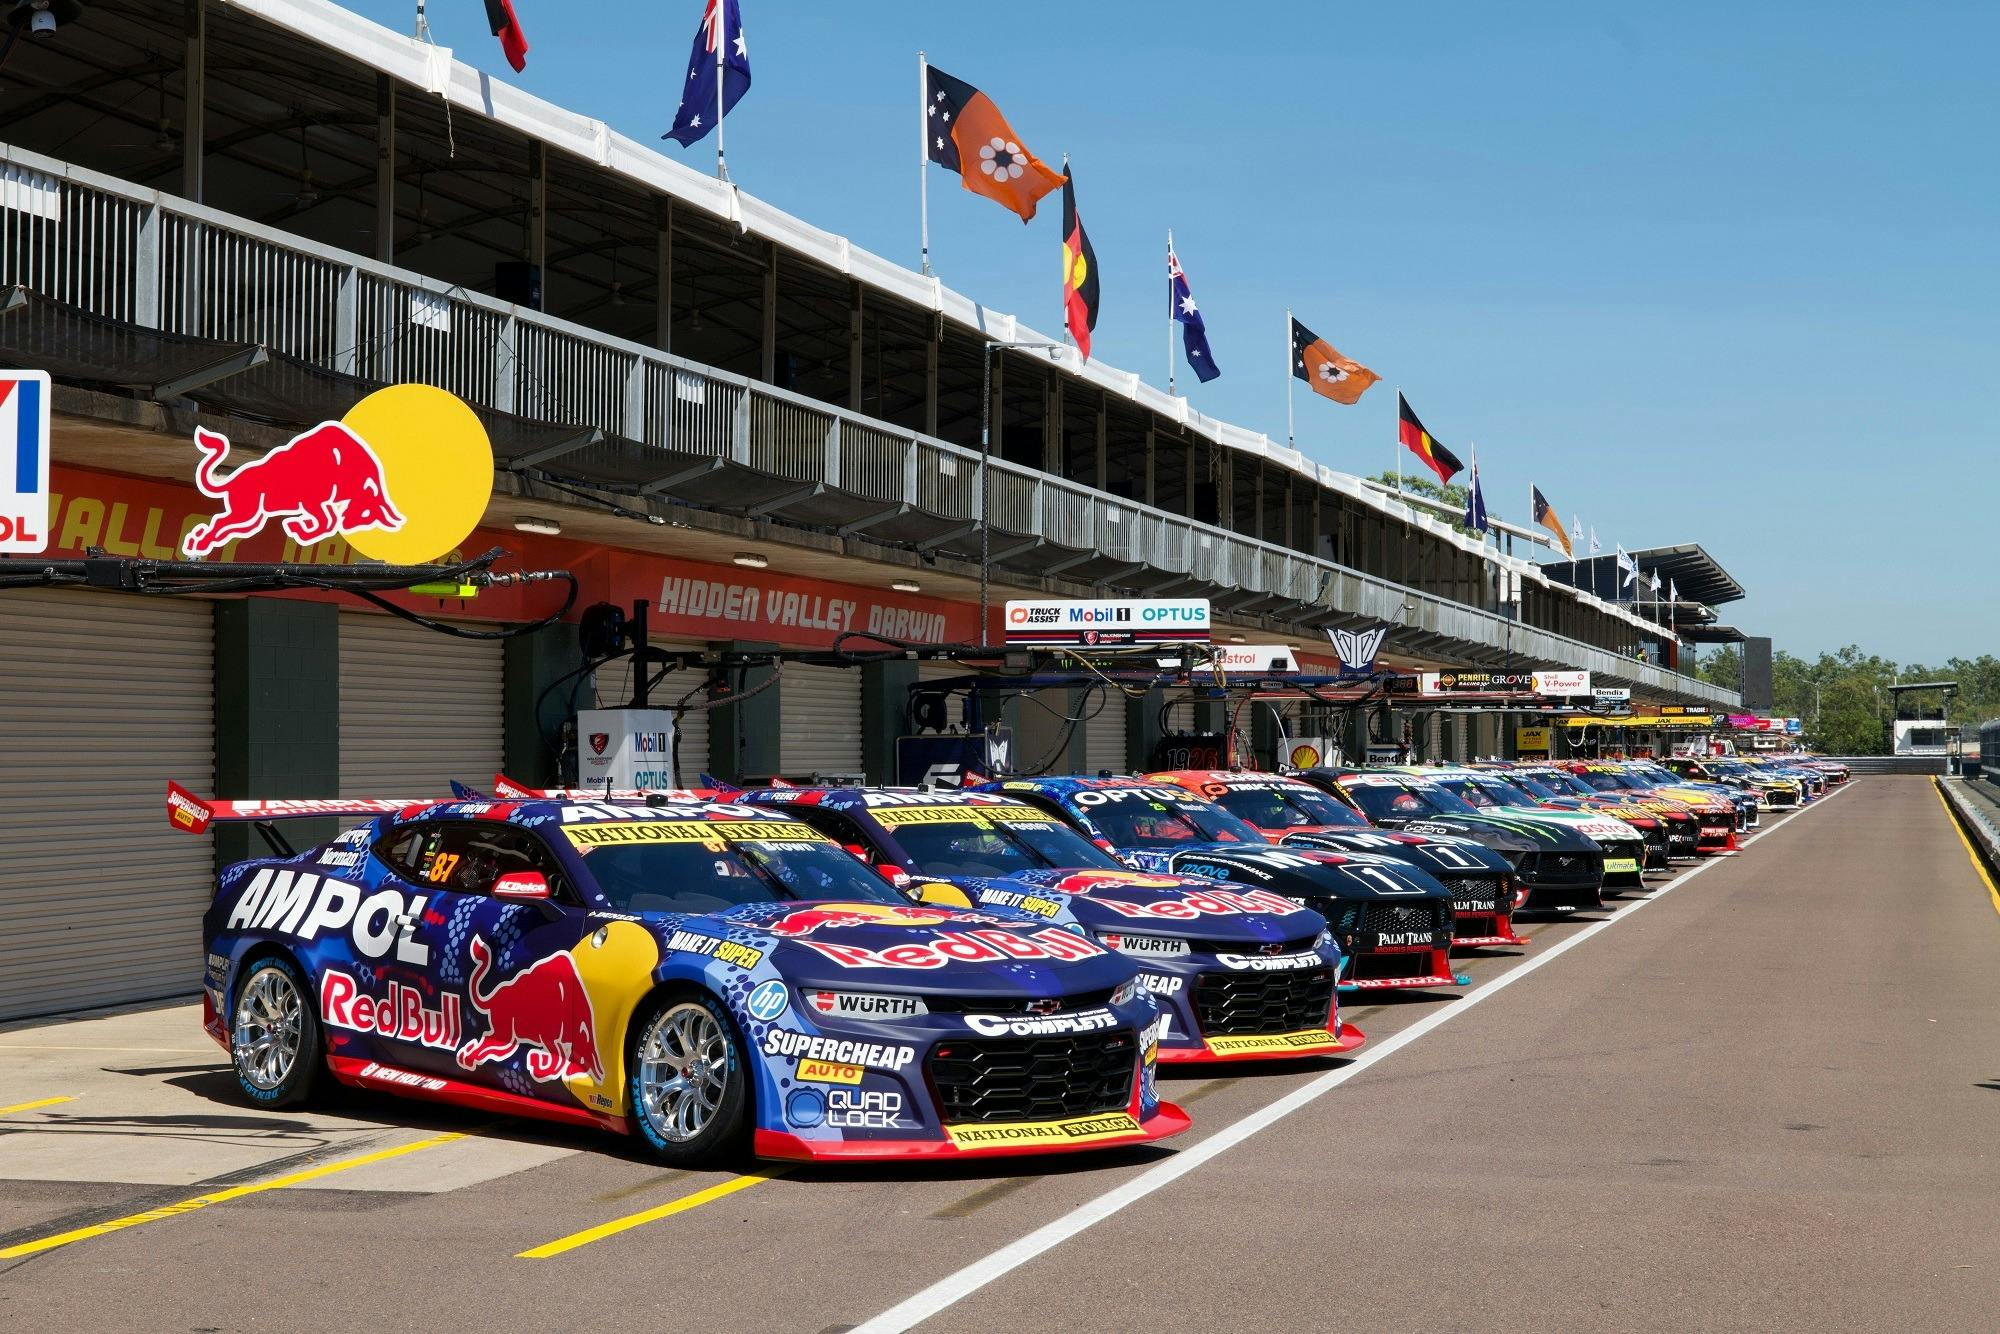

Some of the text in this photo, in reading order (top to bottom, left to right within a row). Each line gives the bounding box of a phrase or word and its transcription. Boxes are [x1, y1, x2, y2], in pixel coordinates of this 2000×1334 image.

[659, 576, 946, 644] HIDDEN VALLEY DARWIN
[1027, 615, 1061, 623] ASSIST
[1030, 608, 1061, 616] TRUCK
[1070, 608, 1113, 622] Mobil
[1142, 608, 1205, 621] OPTUS
[1457, 673, 1490, 682] PENRITE
[1491, 675, 1531, 684] GROVE
[635, 732, 657, 752] Mobil
[635, 771, 668, 789] OPTUS
[771, 792, 802, 801] FEENEY
[168, 791, 210, 822] SUPERCHEAP
[459, 804, 492, 814] BROWN
[561, 803, 791, 823] AMPOL
[874, 807, 979, 823] NATIONAL
[176, 811, 192, 824] AUTO
[568, 824, 821, 844] NATIONAL STORAGE
[1404, 824, 1447, 834] GoPro
[316, 848, 360, 866] Norman
[1434, 846, 1470, 867] 1
[1606, 861, 1635, 870] ultimate
[429, 853, 460, 882] 87
[1180, 863, 1231, 880] move
[1361, 867, 1404, 891] 1
[978, 888, 1013, 904] MAKE
[1019, 895, 1062, 919] SUPER
[1453, 900, 1495, 911] ALM TRANS
[226, 868, 428, 966] AMPOL
[594, 911, 642, 922] DUNLOP
[1123, 937, 1182, 953] WÜRTH
[1378, 931, 1433, 946] PALM TRANS
[667, 930, 764, 970] MAKE IT SUPER
[1215, 951, 1322, 971] COMPLETE
[754, 984, 783, 1019] hp
[838, 994, 917, 1015] WÜRTH
[963, 1012, 1118, 1037] COMPLETE
[763, 1029, 915, 1071] SUPERCHEAP
[1212, 1038, 1288, 1050] NATIONAL
[804, 1065, 857, 1079] AUTO
[828, 1090, 902, 1111] QUAD
[828, 1110, 902, 1129] LOCK
[957, 1116, 1137, 1143] NATIONAL STORAGE
